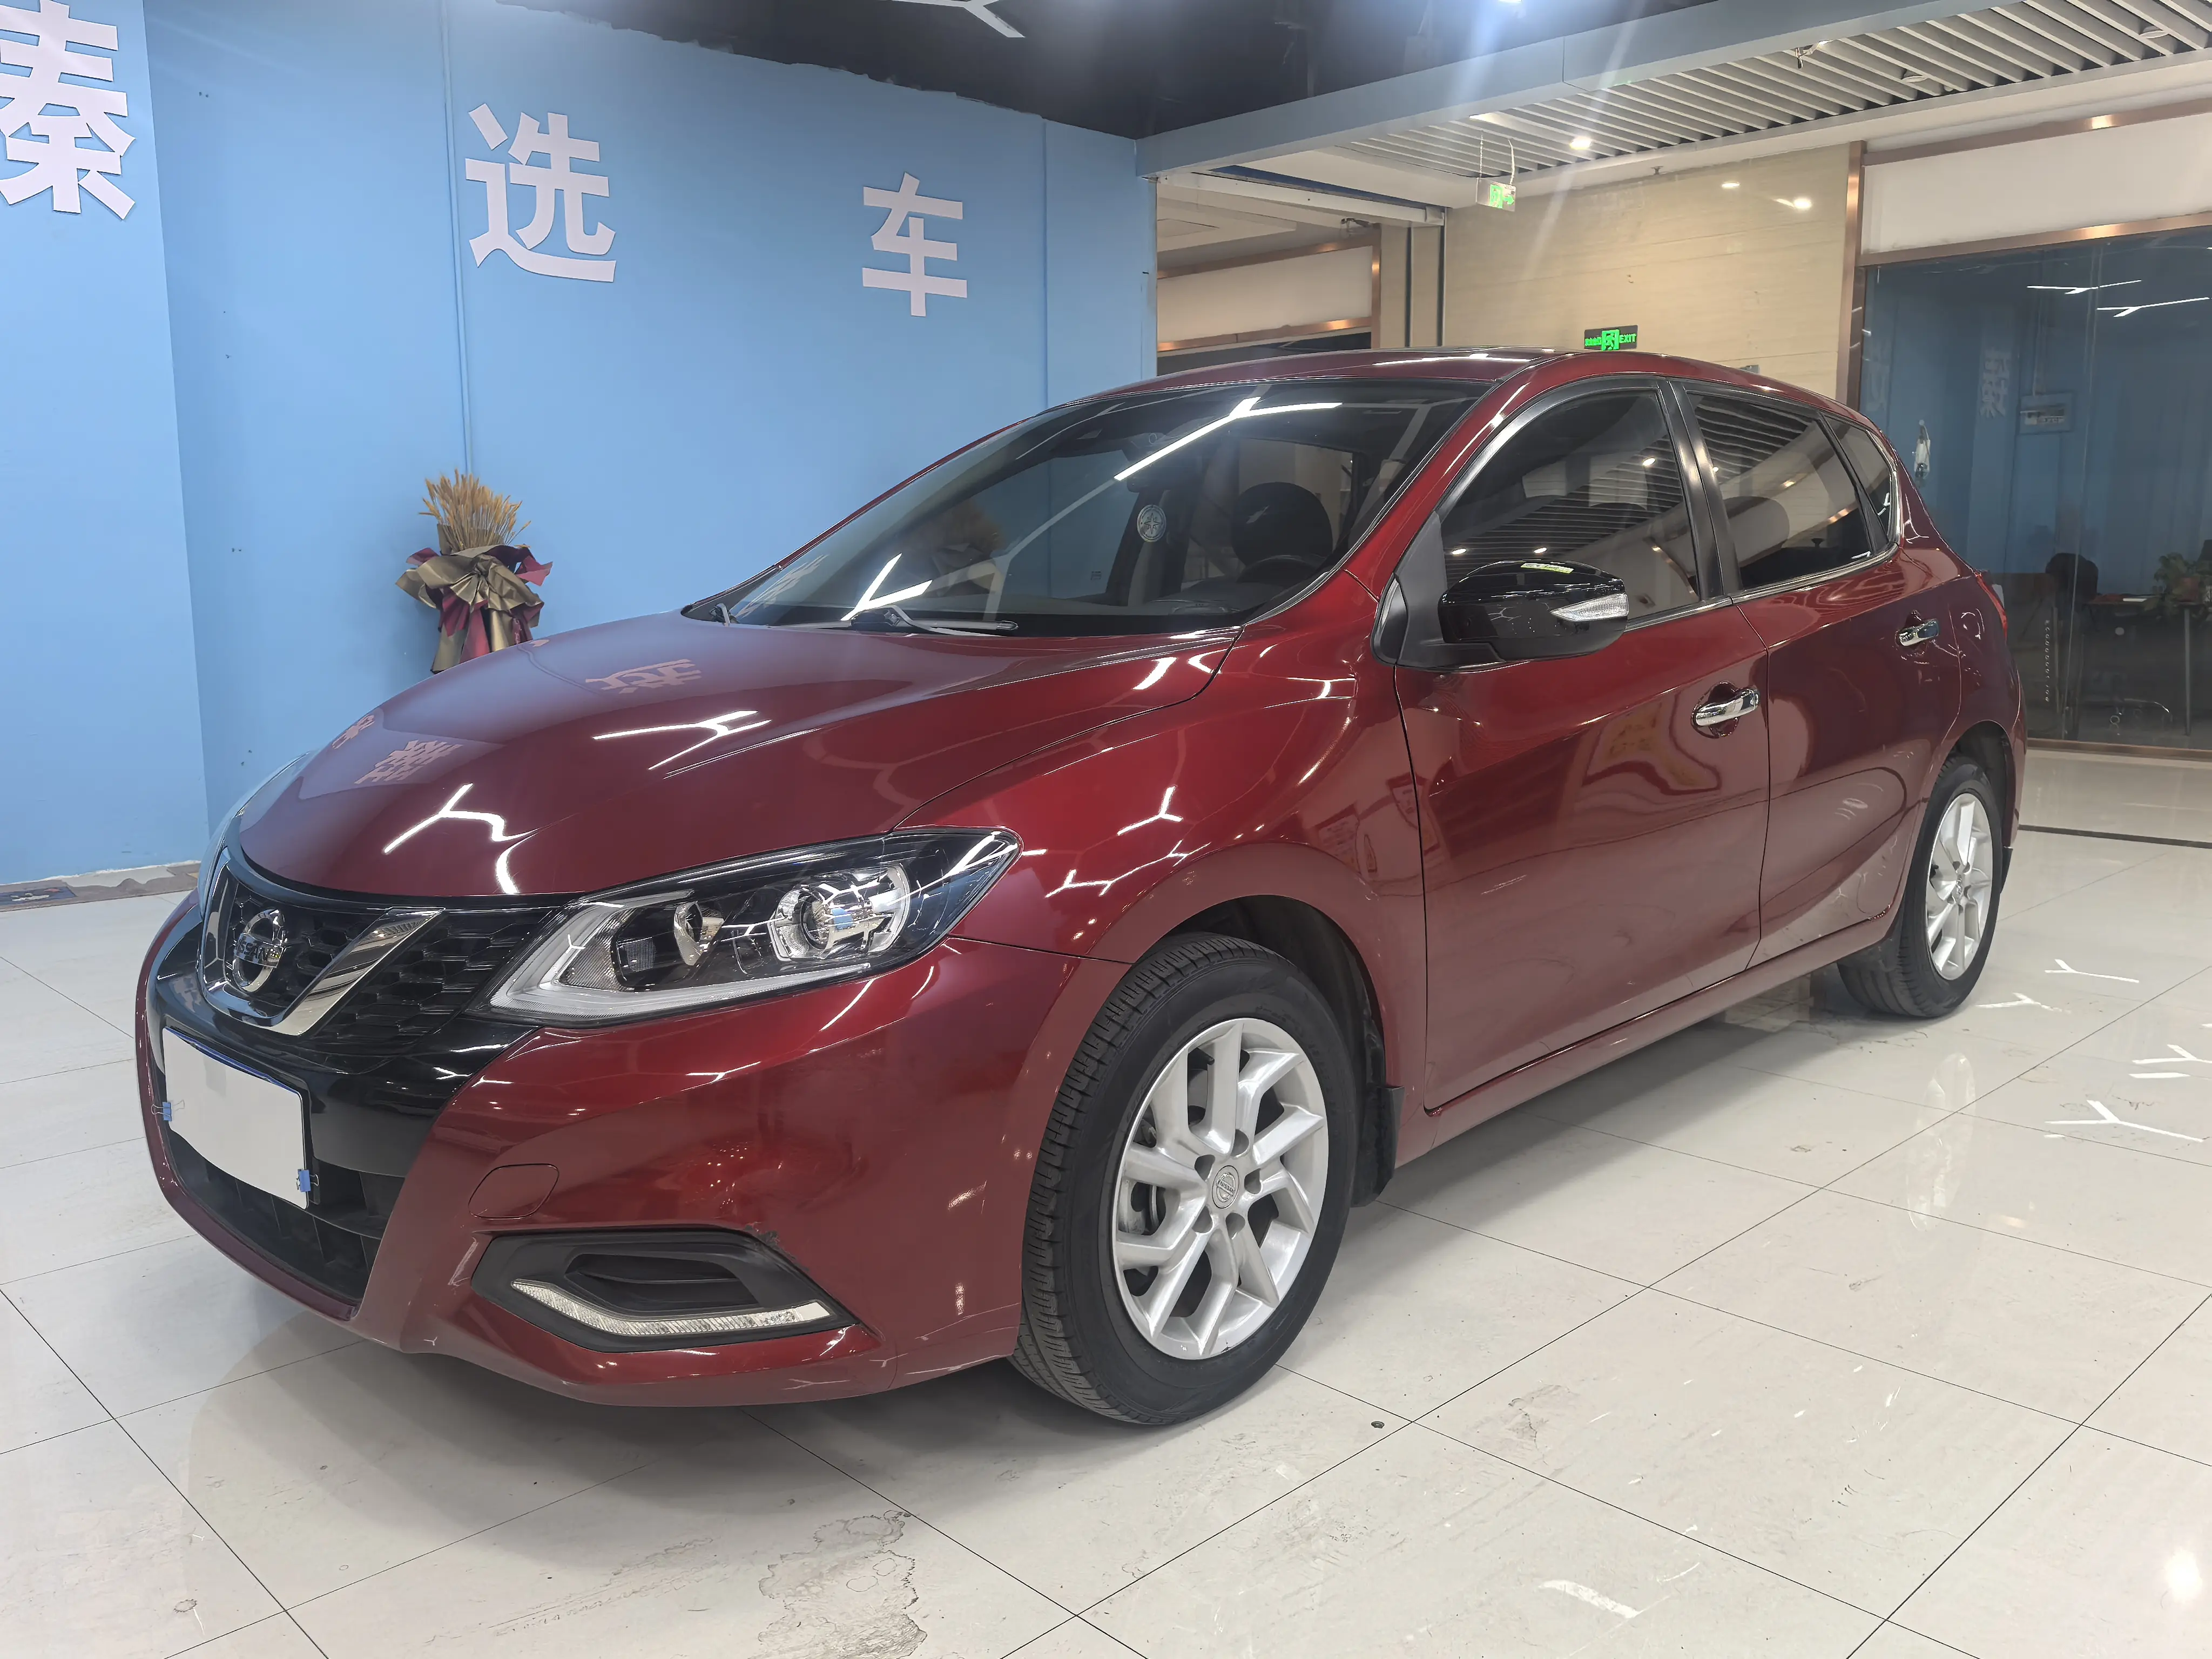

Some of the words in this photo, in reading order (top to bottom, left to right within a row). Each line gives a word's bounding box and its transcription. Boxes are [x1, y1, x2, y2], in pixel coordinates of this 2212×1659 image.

[465, 103, 617, 282] 选
[862, 171, 968, 317] 车
[1619, 333, 1637, 343] EXIT
[1219, 1181, 1233, 1194] NISSAN
